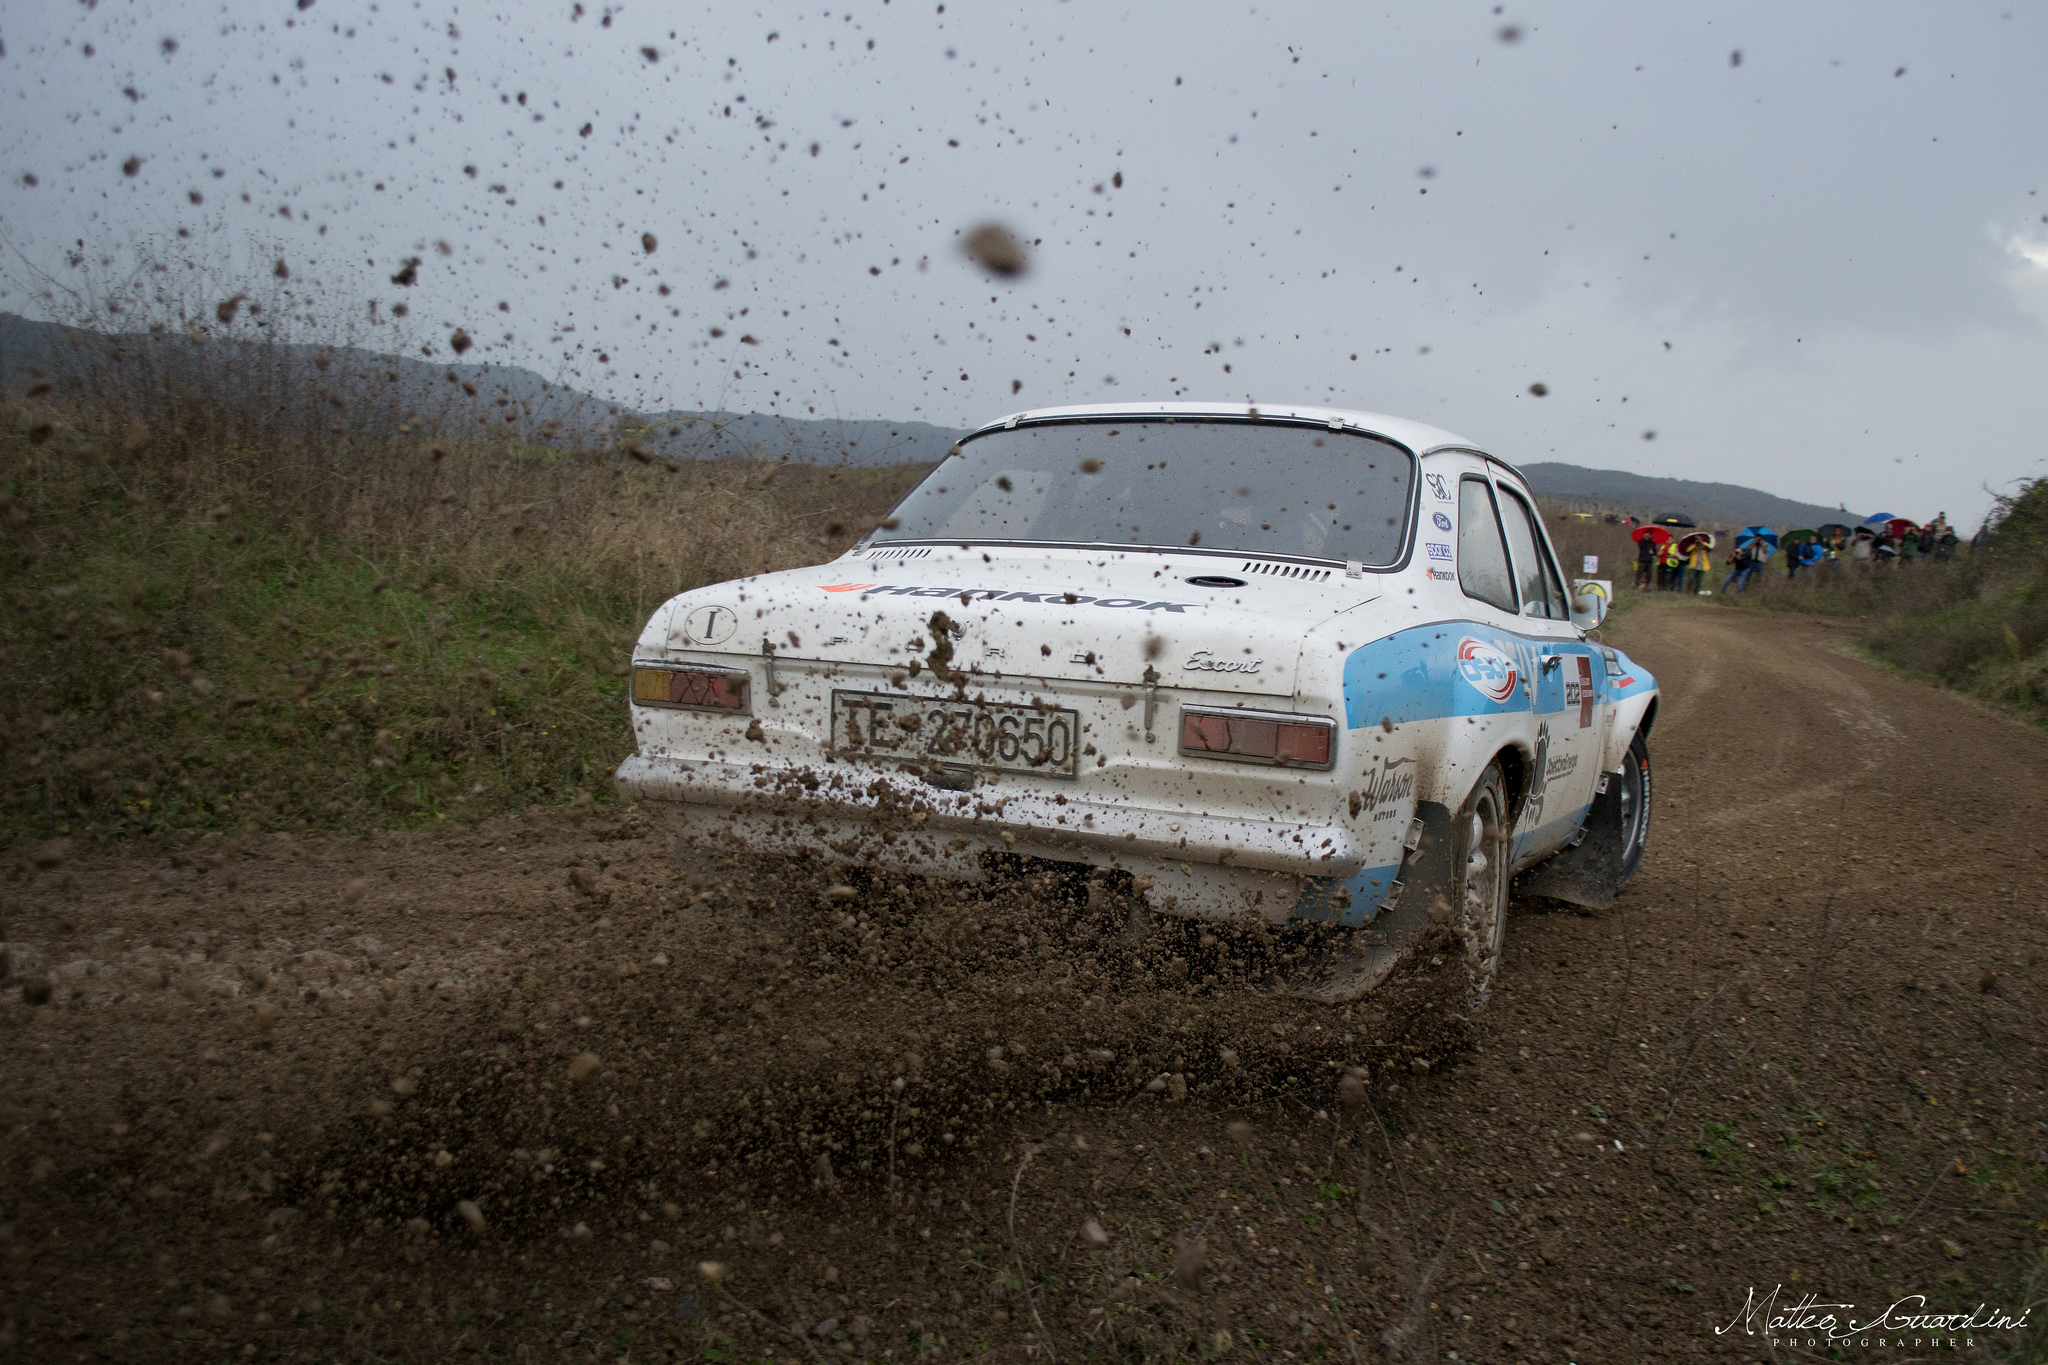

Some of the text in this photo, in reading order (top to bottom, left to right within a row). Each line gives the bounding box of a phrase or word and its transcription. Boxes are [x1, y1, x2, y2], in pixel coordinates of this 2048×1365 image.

[704, 610, 718, 640] I
[1183, 650, 1263, 674] Escort
[927, 708, 1070, 767] 270650
